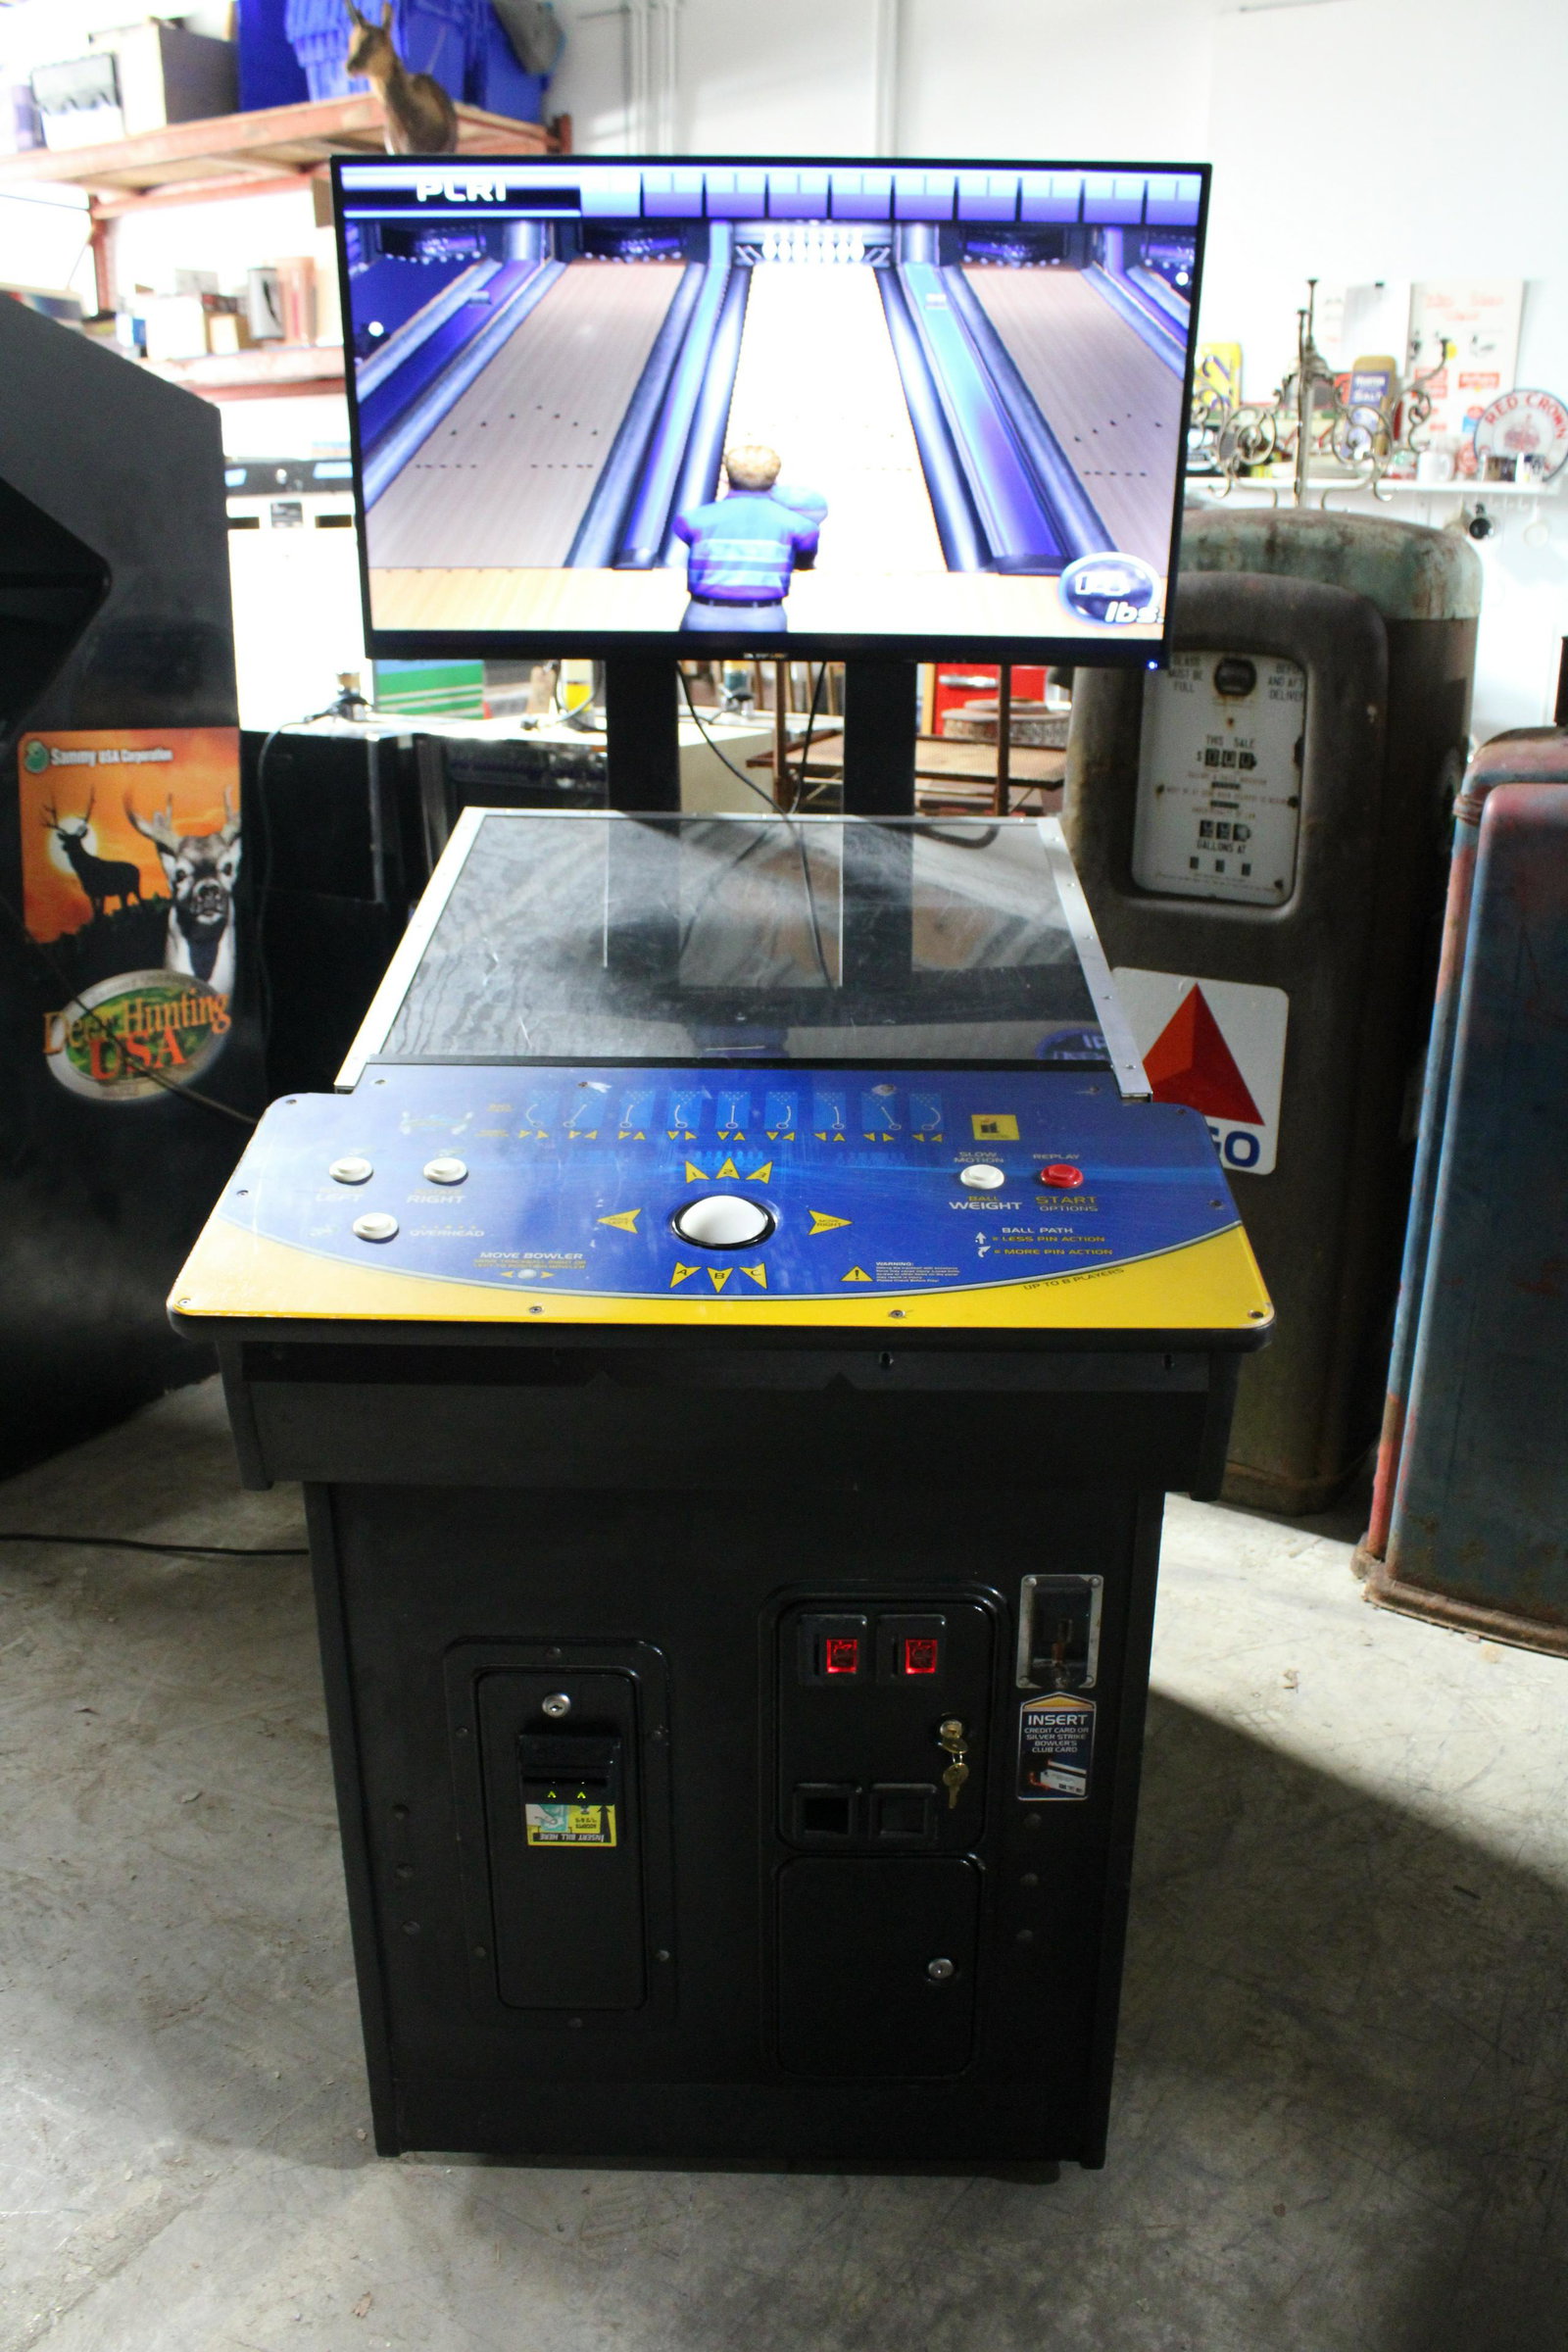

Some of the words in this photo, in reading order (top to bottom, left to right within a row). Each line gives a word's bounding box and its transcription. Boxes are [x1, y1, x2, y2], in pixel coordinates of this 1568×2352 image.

[1485, 396, 1519, 425] RED
[1525, 393, 1566, 439] CROWN
[1206, 734, 1224, 746] THIS
[1235, 737, 1255, 749] SALE
[51, 747, 96, 767] Sammy
[98, 749, 120, 763] USA
[121, 747, 173, 763] Corporation
[43, 1009, 116, 1054] Deer
[121, 987, 232, 1035] Hunting
[88, 1026, 187, 1082] USA
[316, 1194, 365, 1202] LEFT
[407, 1195, 466, 1203] RIGHT
[949, 1201, 1023, 1210] WEIGHT
[1072, 1268, 1125, 1283] PLAYERS
[1028, 1714, 1088, 1725] INSERT
